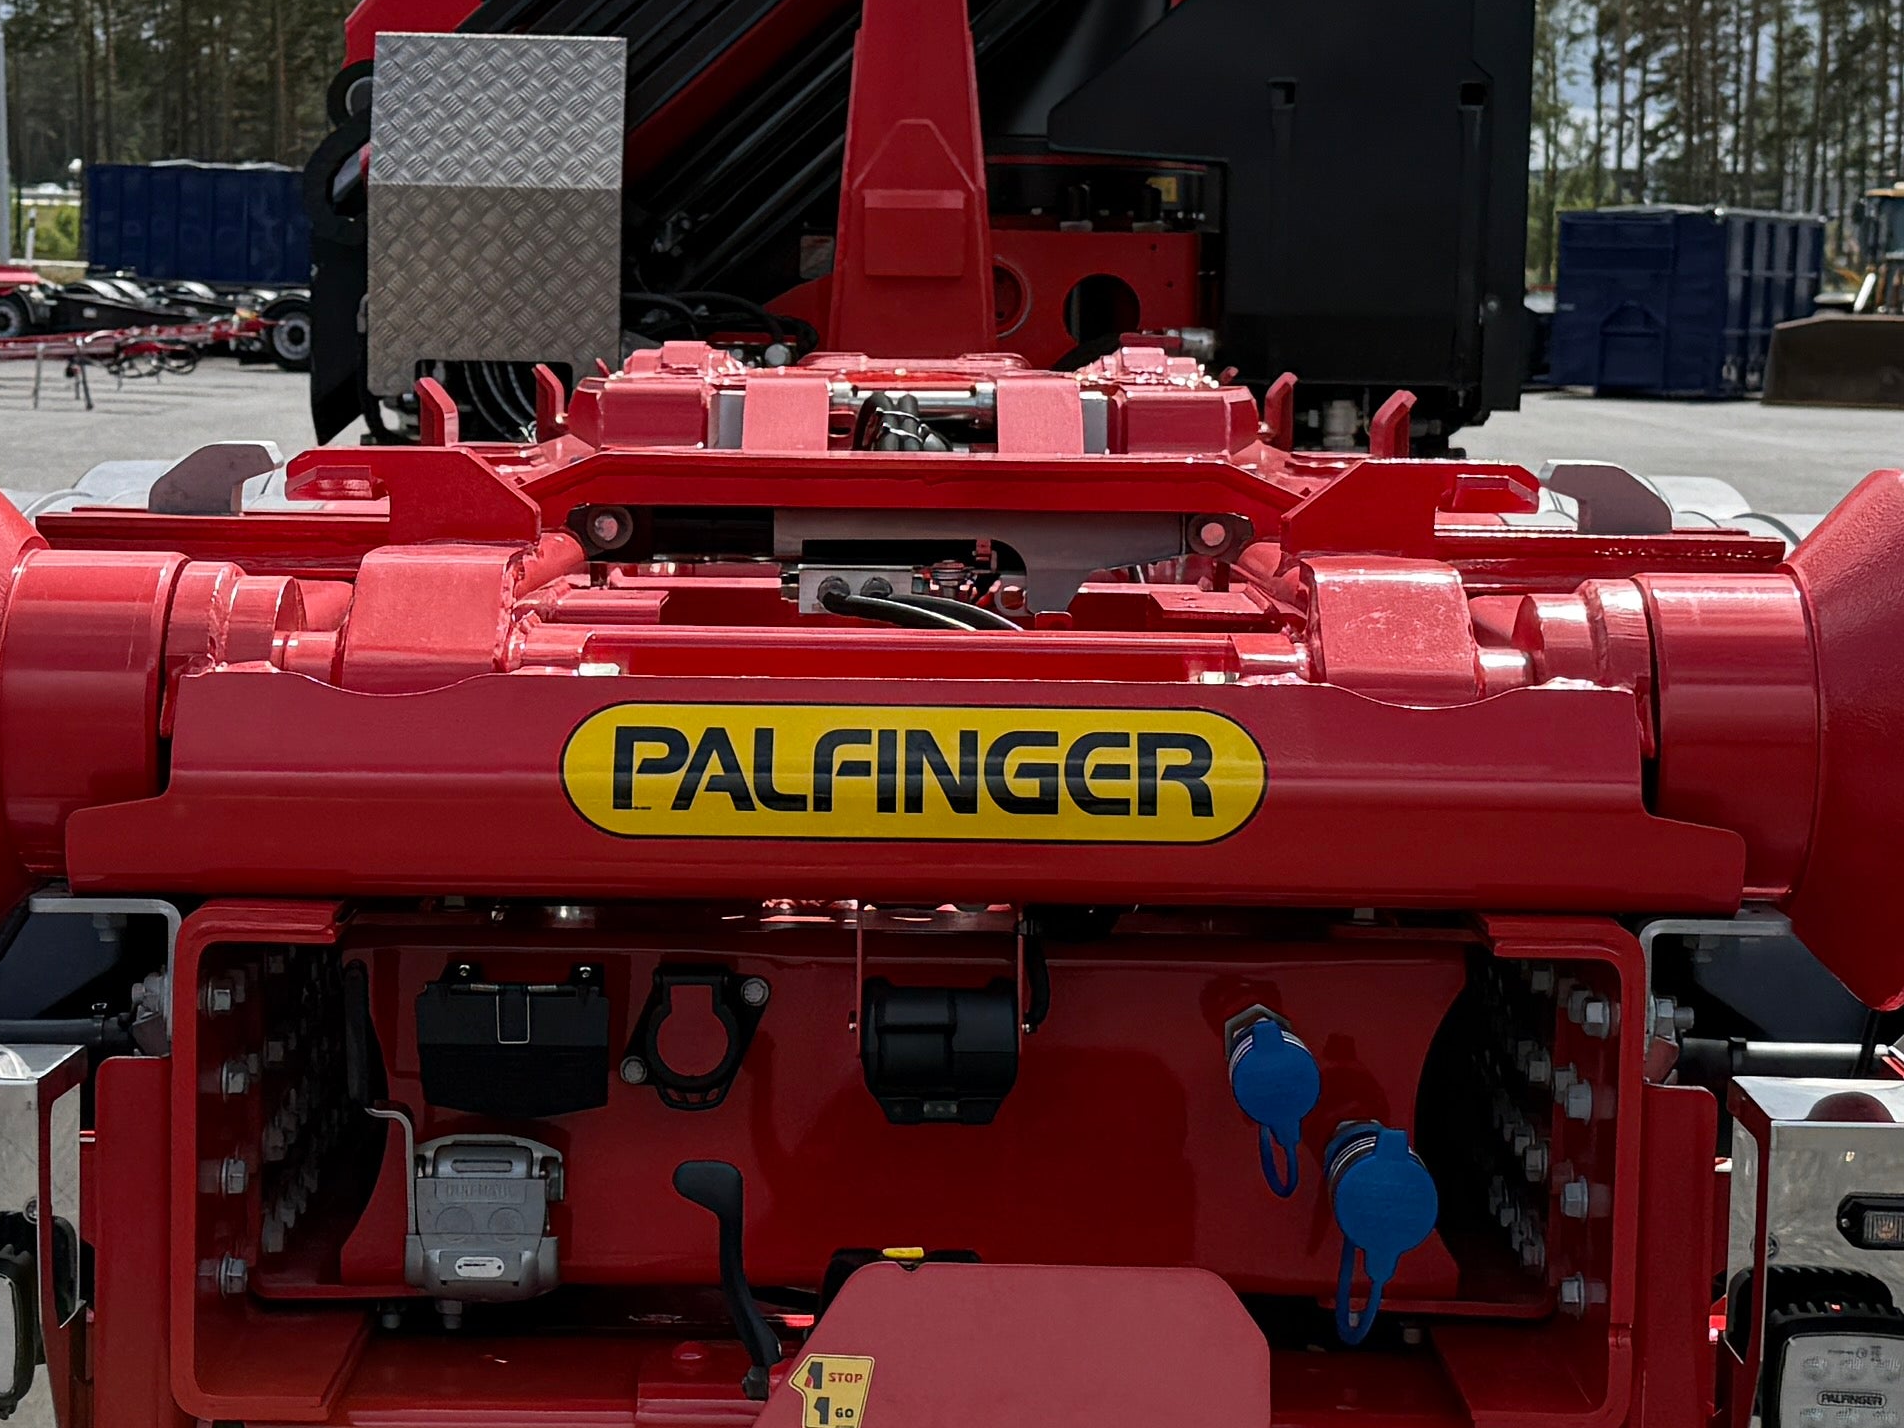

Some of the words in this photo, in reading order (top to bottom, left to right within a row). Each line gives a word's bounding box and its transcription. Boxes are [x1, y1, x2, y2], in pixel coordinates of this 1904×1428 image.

[612, 725, 1215, 818] PALFINGER
[828, 1372, 863, 1383] STOP
[835, 1407, 854, 1418] GO
